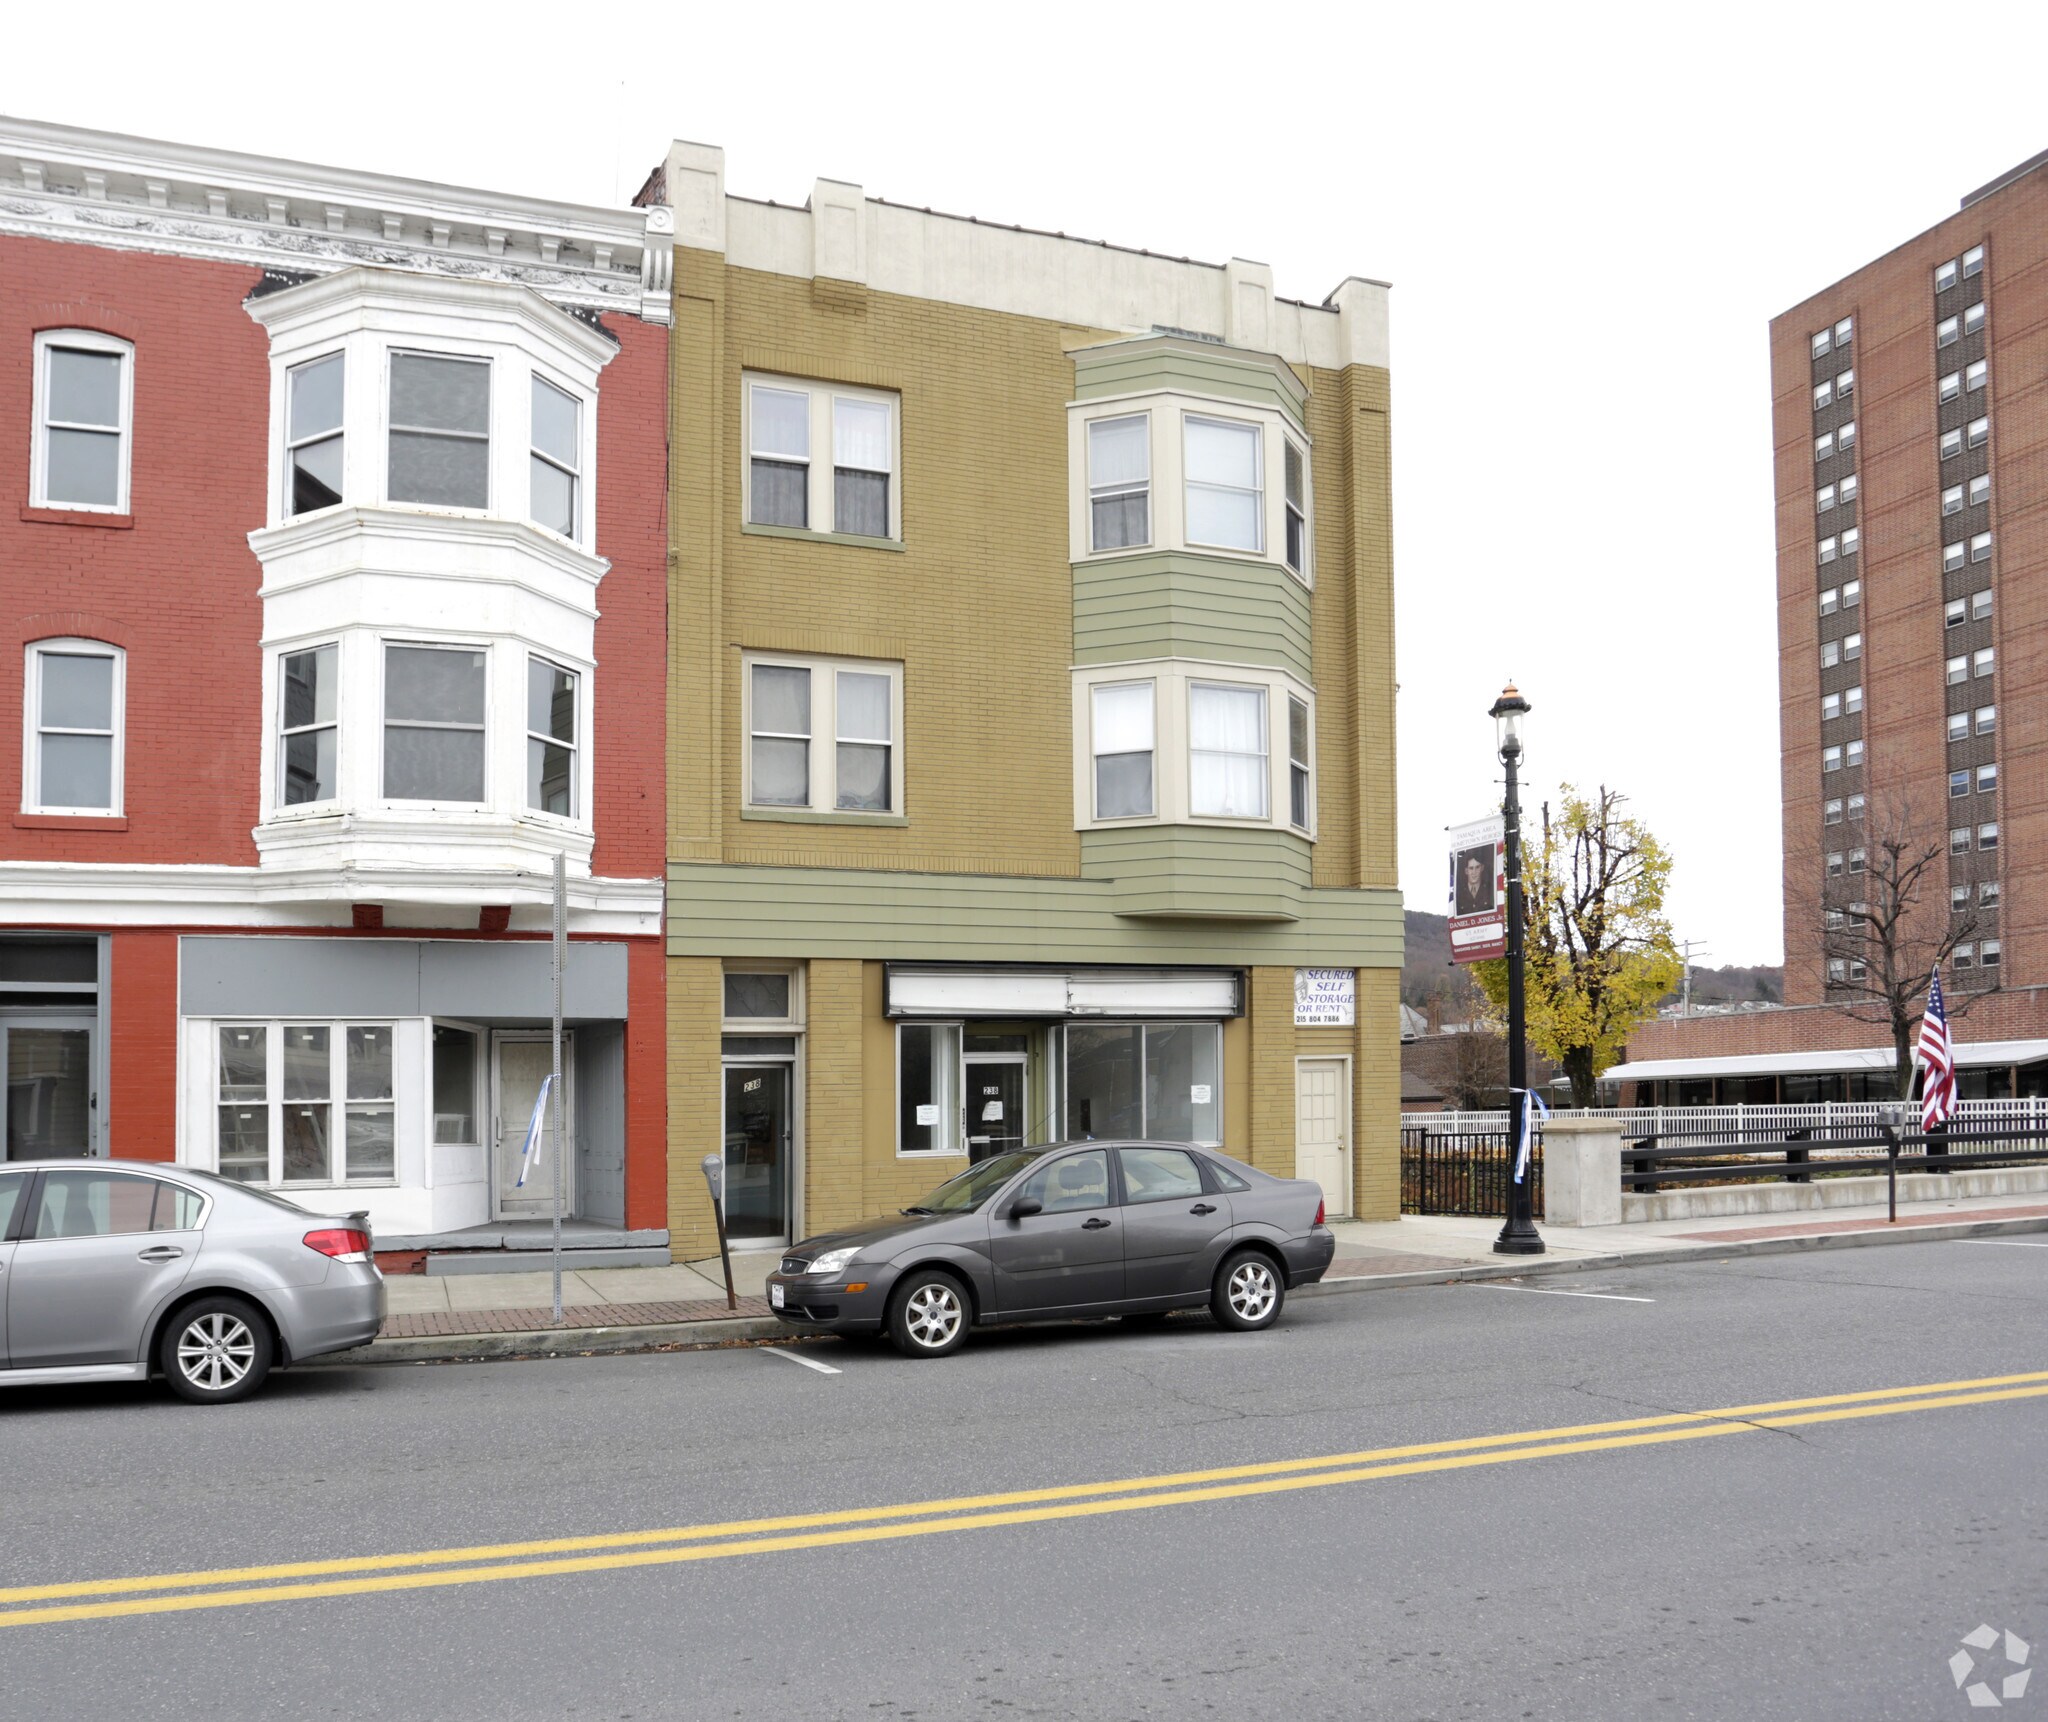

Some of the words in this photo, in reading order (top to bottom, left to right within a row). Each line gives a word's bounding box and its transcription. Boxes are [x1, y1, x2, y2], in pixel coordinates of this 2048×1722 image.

[1450, 920, 1470, 929] DANIEL
[1477, 915, 1496, 925] JONES
[1306, 969, 1355, 980] SECURED
[1315, 982, 1346, 992] SELF
[1306, 994, 1355, 1004] STORAGE
[1315, 1004, 1342, 1013] RENT
[1296, 1015, 1307, 1023] 215
[745, 1079, 760, 1092] 238
